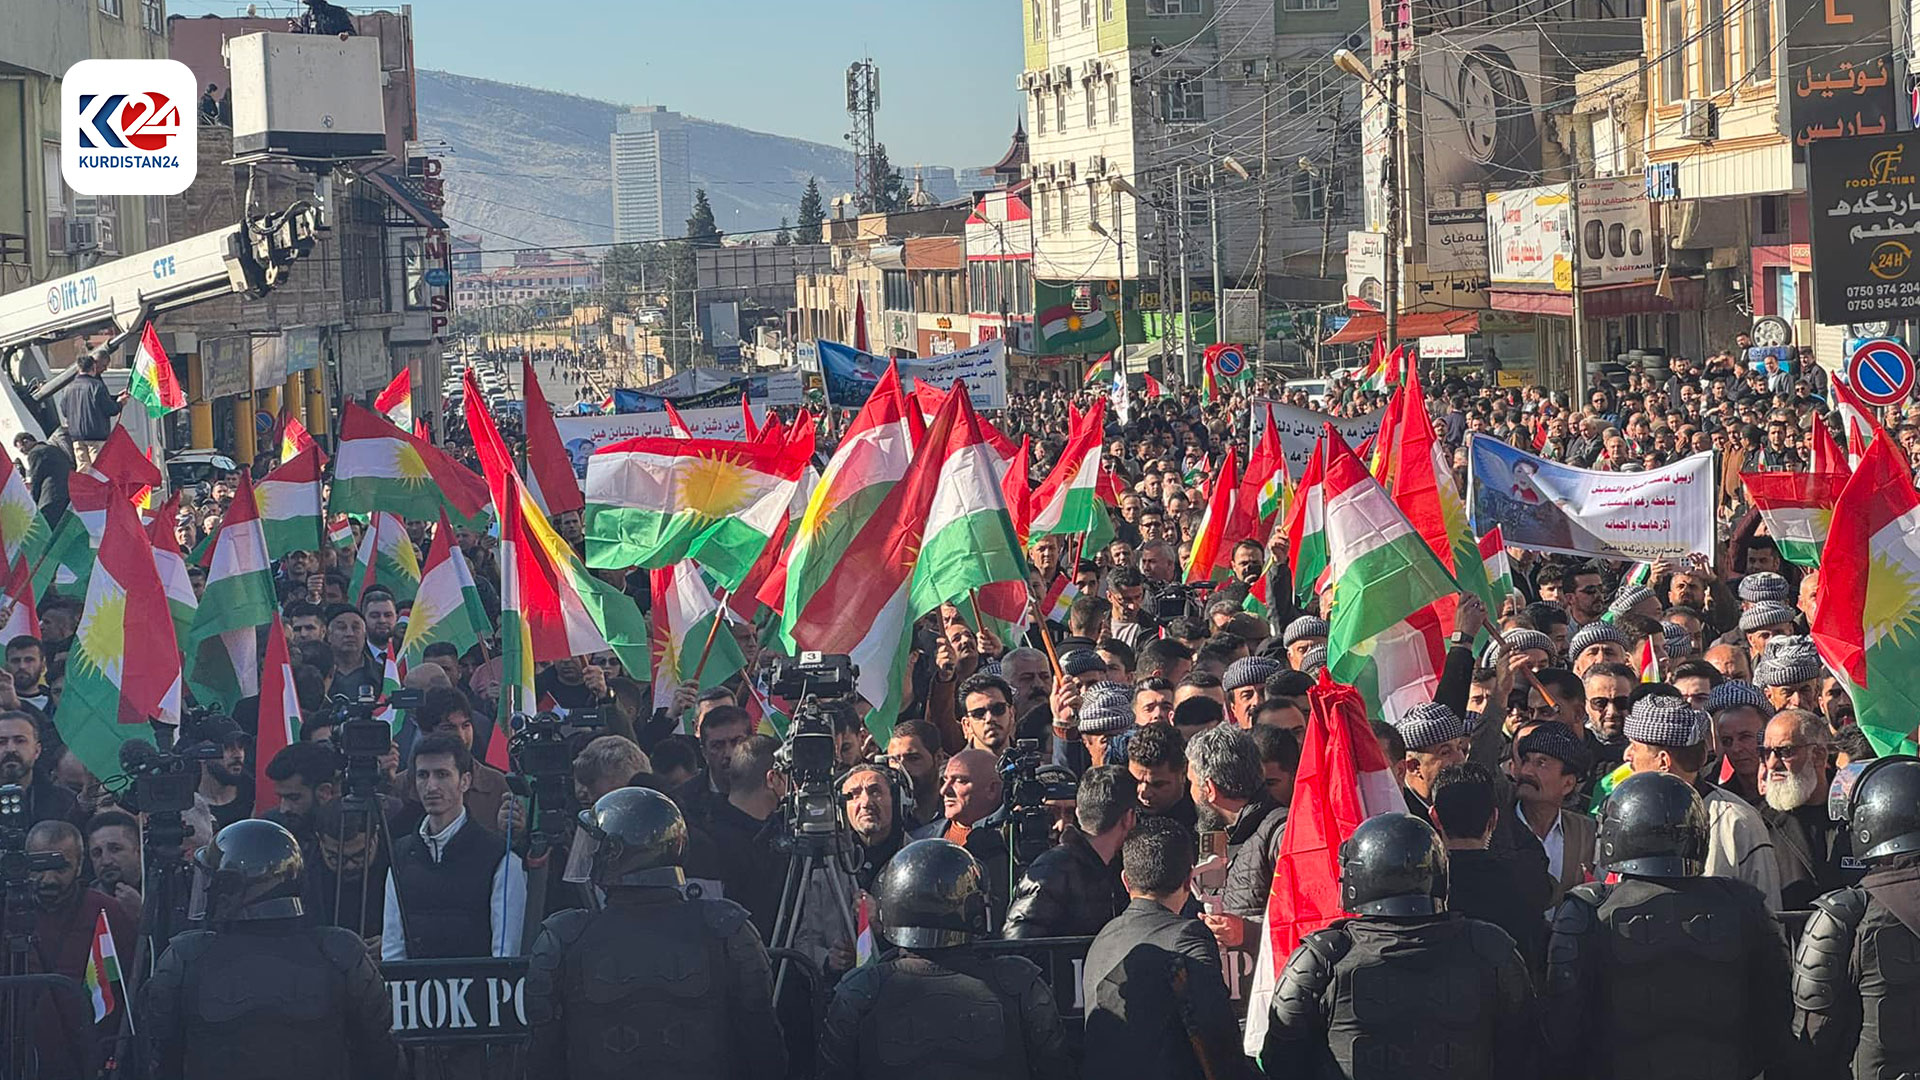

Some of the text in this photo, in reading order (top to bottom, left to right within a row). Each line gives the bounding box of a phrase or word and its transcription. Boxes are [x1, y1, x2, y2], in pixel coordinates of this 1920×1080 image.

[1845, 179, 1877, 189] FOOD
[153, 255, 176, 279] CTE
[1878, 252, 1904, 269] 24H
[61, 275, 98, 311] lift 270
[1846, 282, 1920, 298] 0750 974 204
[1847, 299, 1875, 311] 0750
[1877, 297, 1898, 309] 954
[384, 977, 478, 1031] HOK
